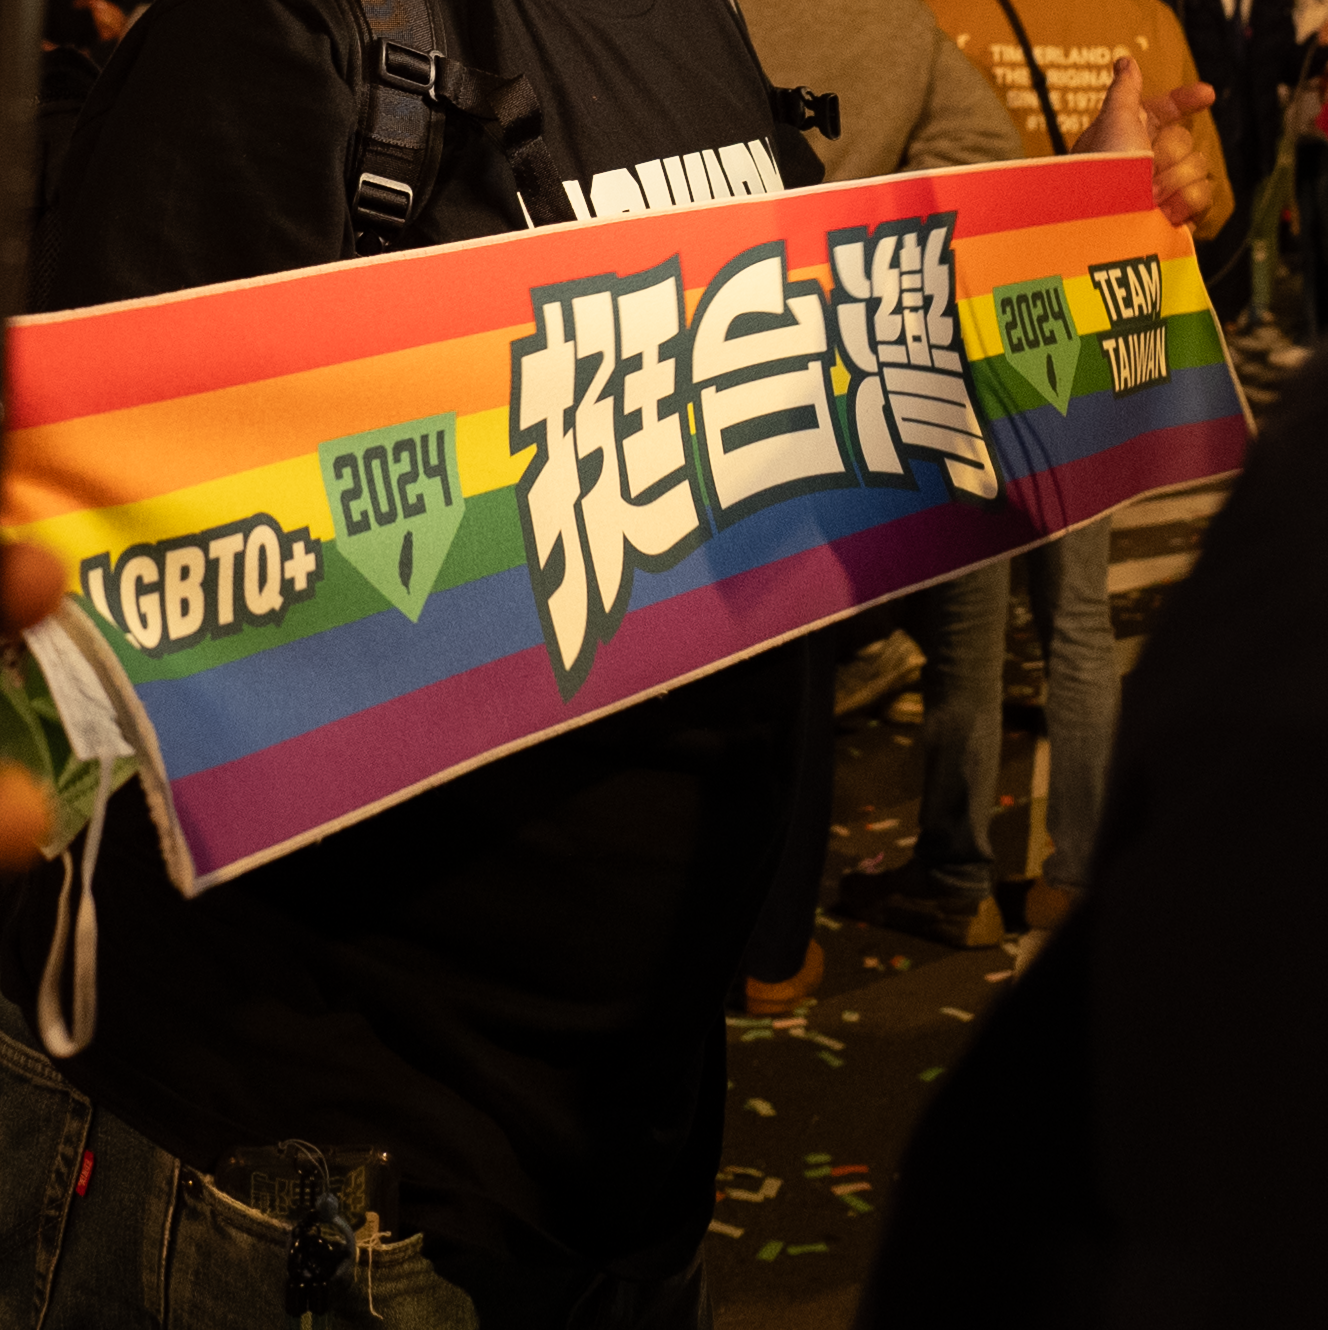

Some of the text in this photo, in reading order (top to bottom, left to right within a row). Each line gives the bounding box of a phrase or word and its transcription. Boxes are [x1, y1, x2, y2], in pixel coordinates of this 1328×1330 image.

[1000, 287, 1073, 354] 2024
[1093, 261, 1161, 321] TEAM
[1102, 326, 1167, 392] TAIWAN
[333, 430, 454, 536] 2024
[520, 226, 999, 671] 挺台灣
[88, 525, 318, 650] LGBTQ+
